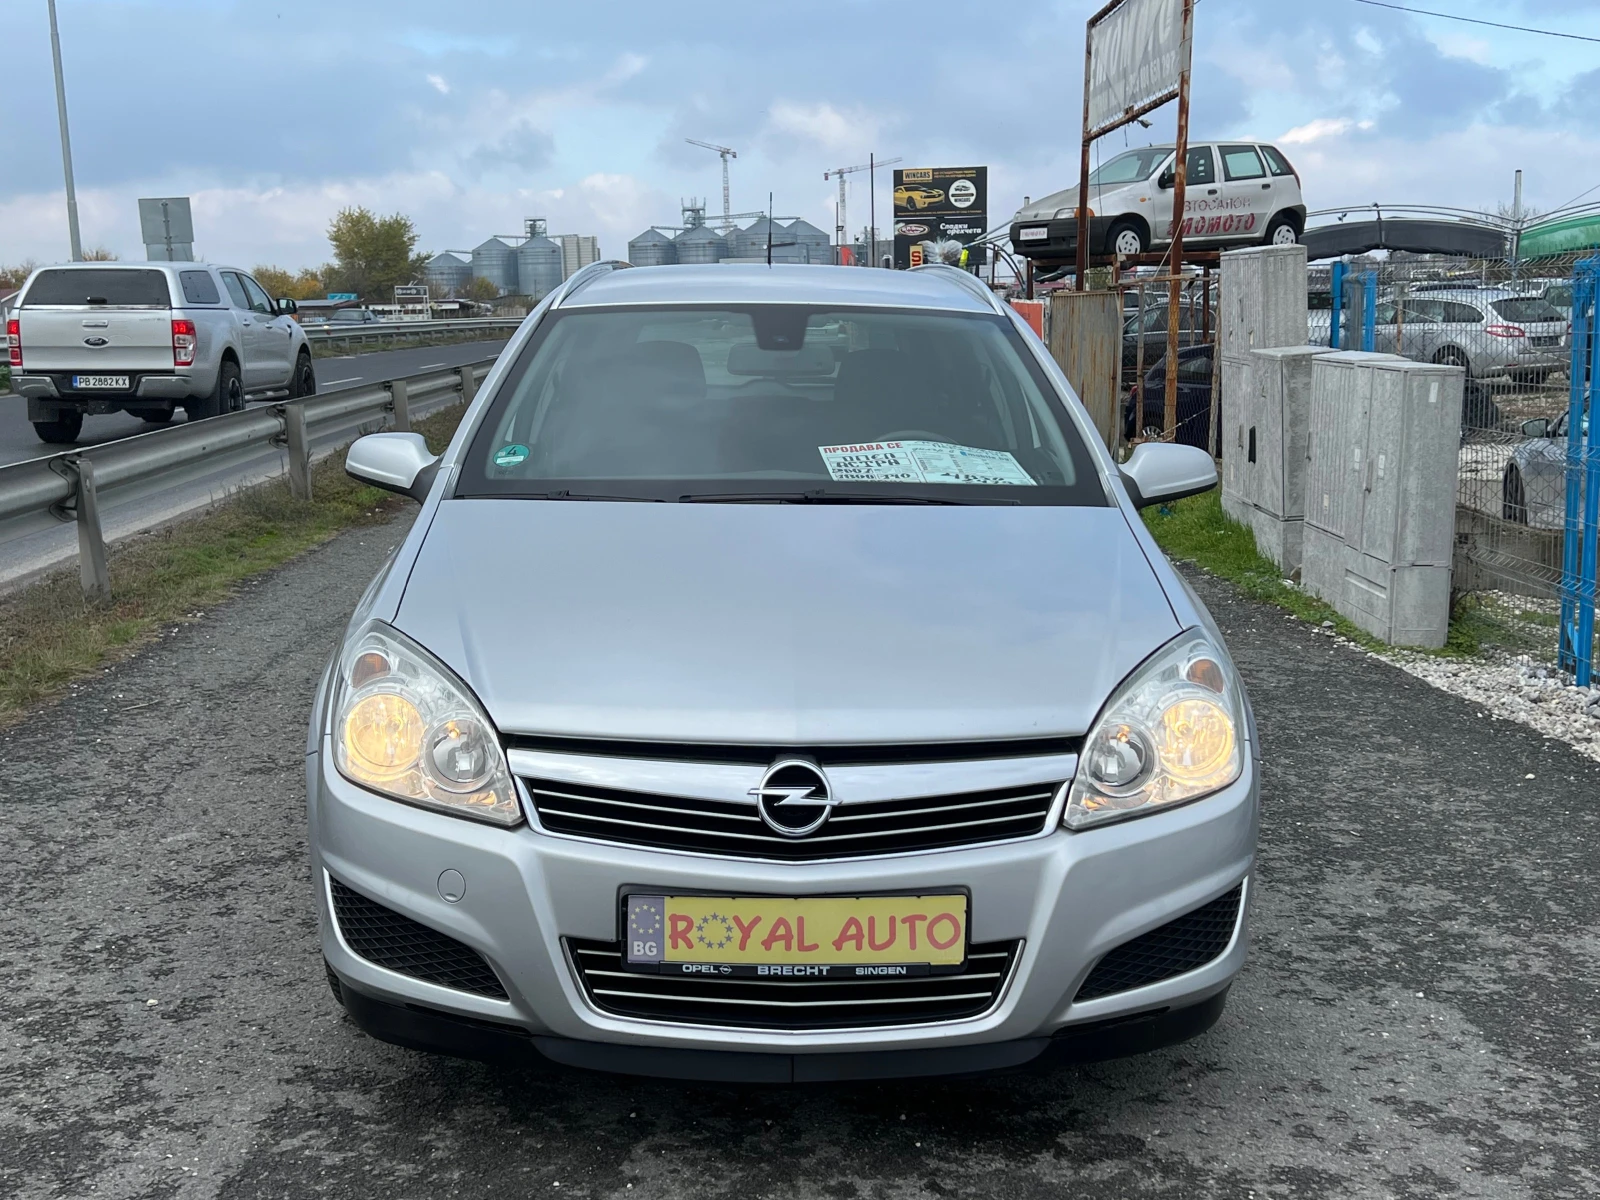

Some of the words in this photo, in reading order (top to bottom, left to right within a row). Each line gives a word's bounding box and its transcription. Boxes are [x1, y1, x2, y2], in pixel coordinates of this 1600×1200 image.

[904, 171, 931, 179] WINCARS
[1184, 196, 1251, 212] ВТОСАЛОН
[79, 377, 91, 387] PB
[115, 377, 127, 387] KX
[506, 446, 518, 456] 4
[823, 443, 884, 453] ПРОДАВА
[836, 459, 900, 468] АСТРА
[832, 913, 961, 951] AUTO
[633, 941, 657, 956] BG
[682, 964, 718, 973] OPEL
[757, 965, 830, 976] BRECHT
[855, 966, 907, 975] SINGEN
